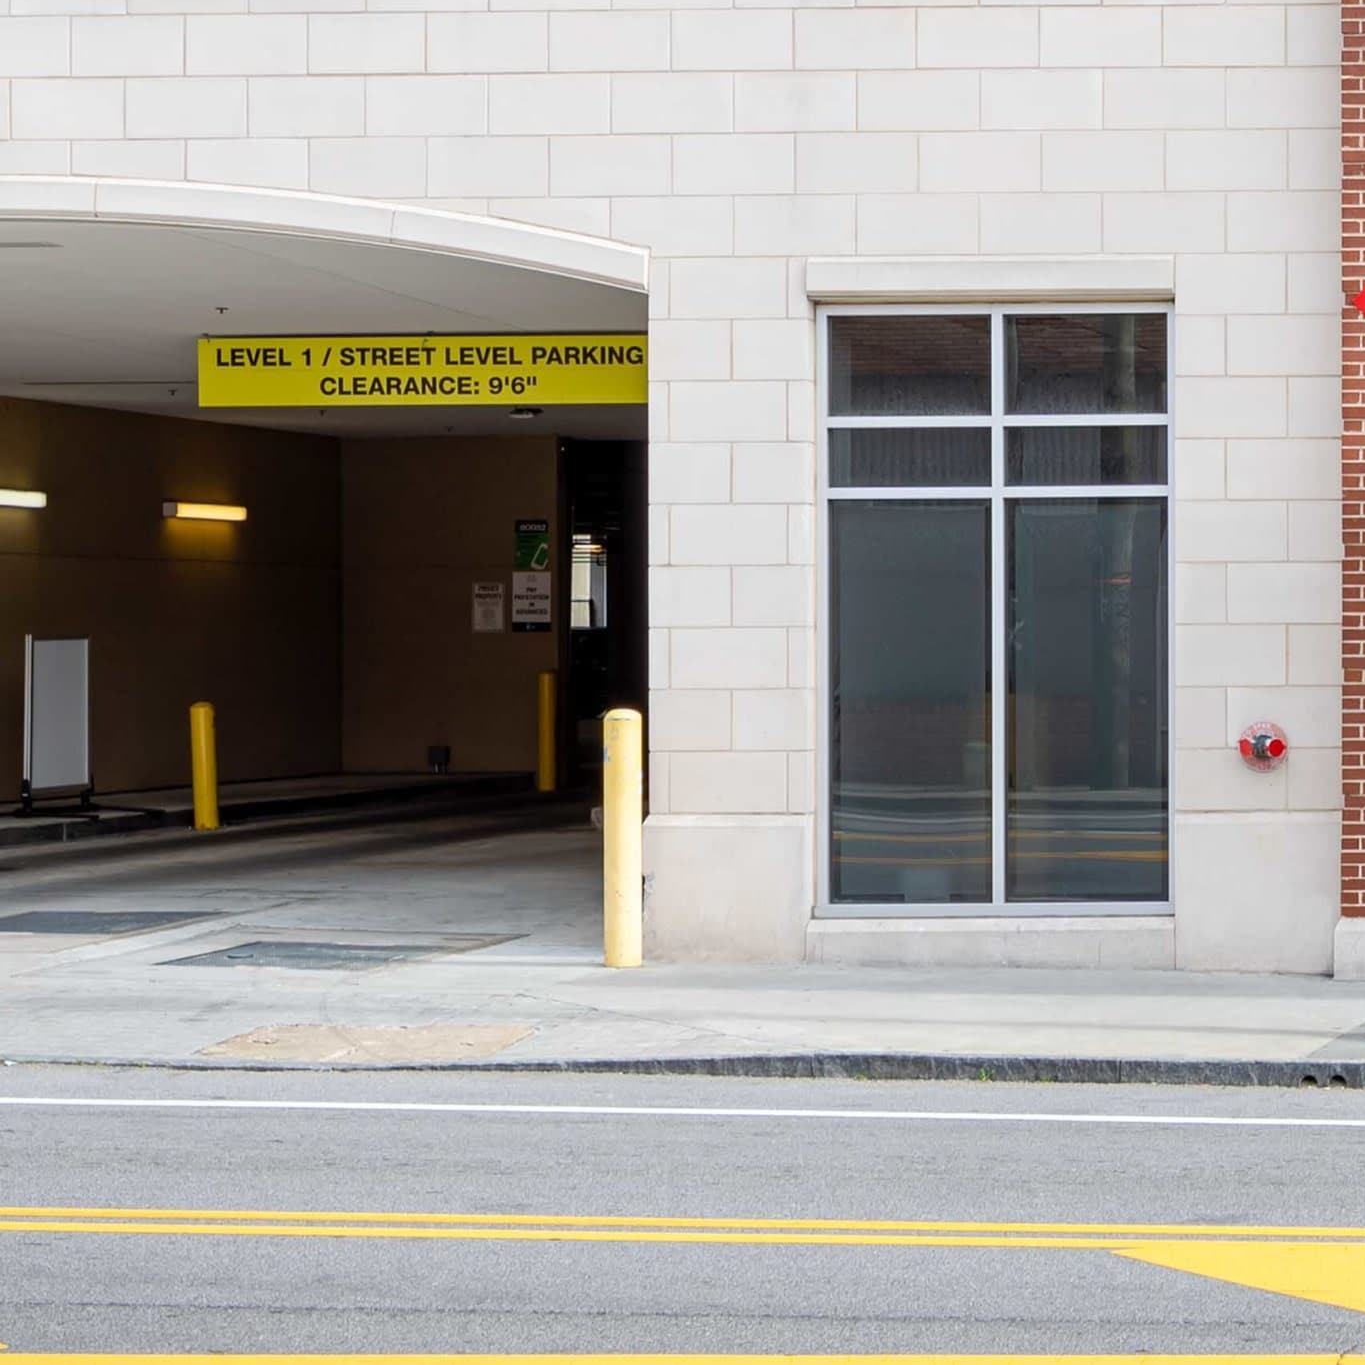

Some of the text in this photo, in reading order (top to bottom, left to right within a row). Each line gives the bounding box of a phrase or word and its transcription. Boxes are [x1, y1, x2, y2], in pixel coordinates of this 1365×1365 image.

[216, 346, 643, 366] LEVEL 1 / STREET LEVEL PARKING
[320, 377, 480, 395] CLEARANCE:
